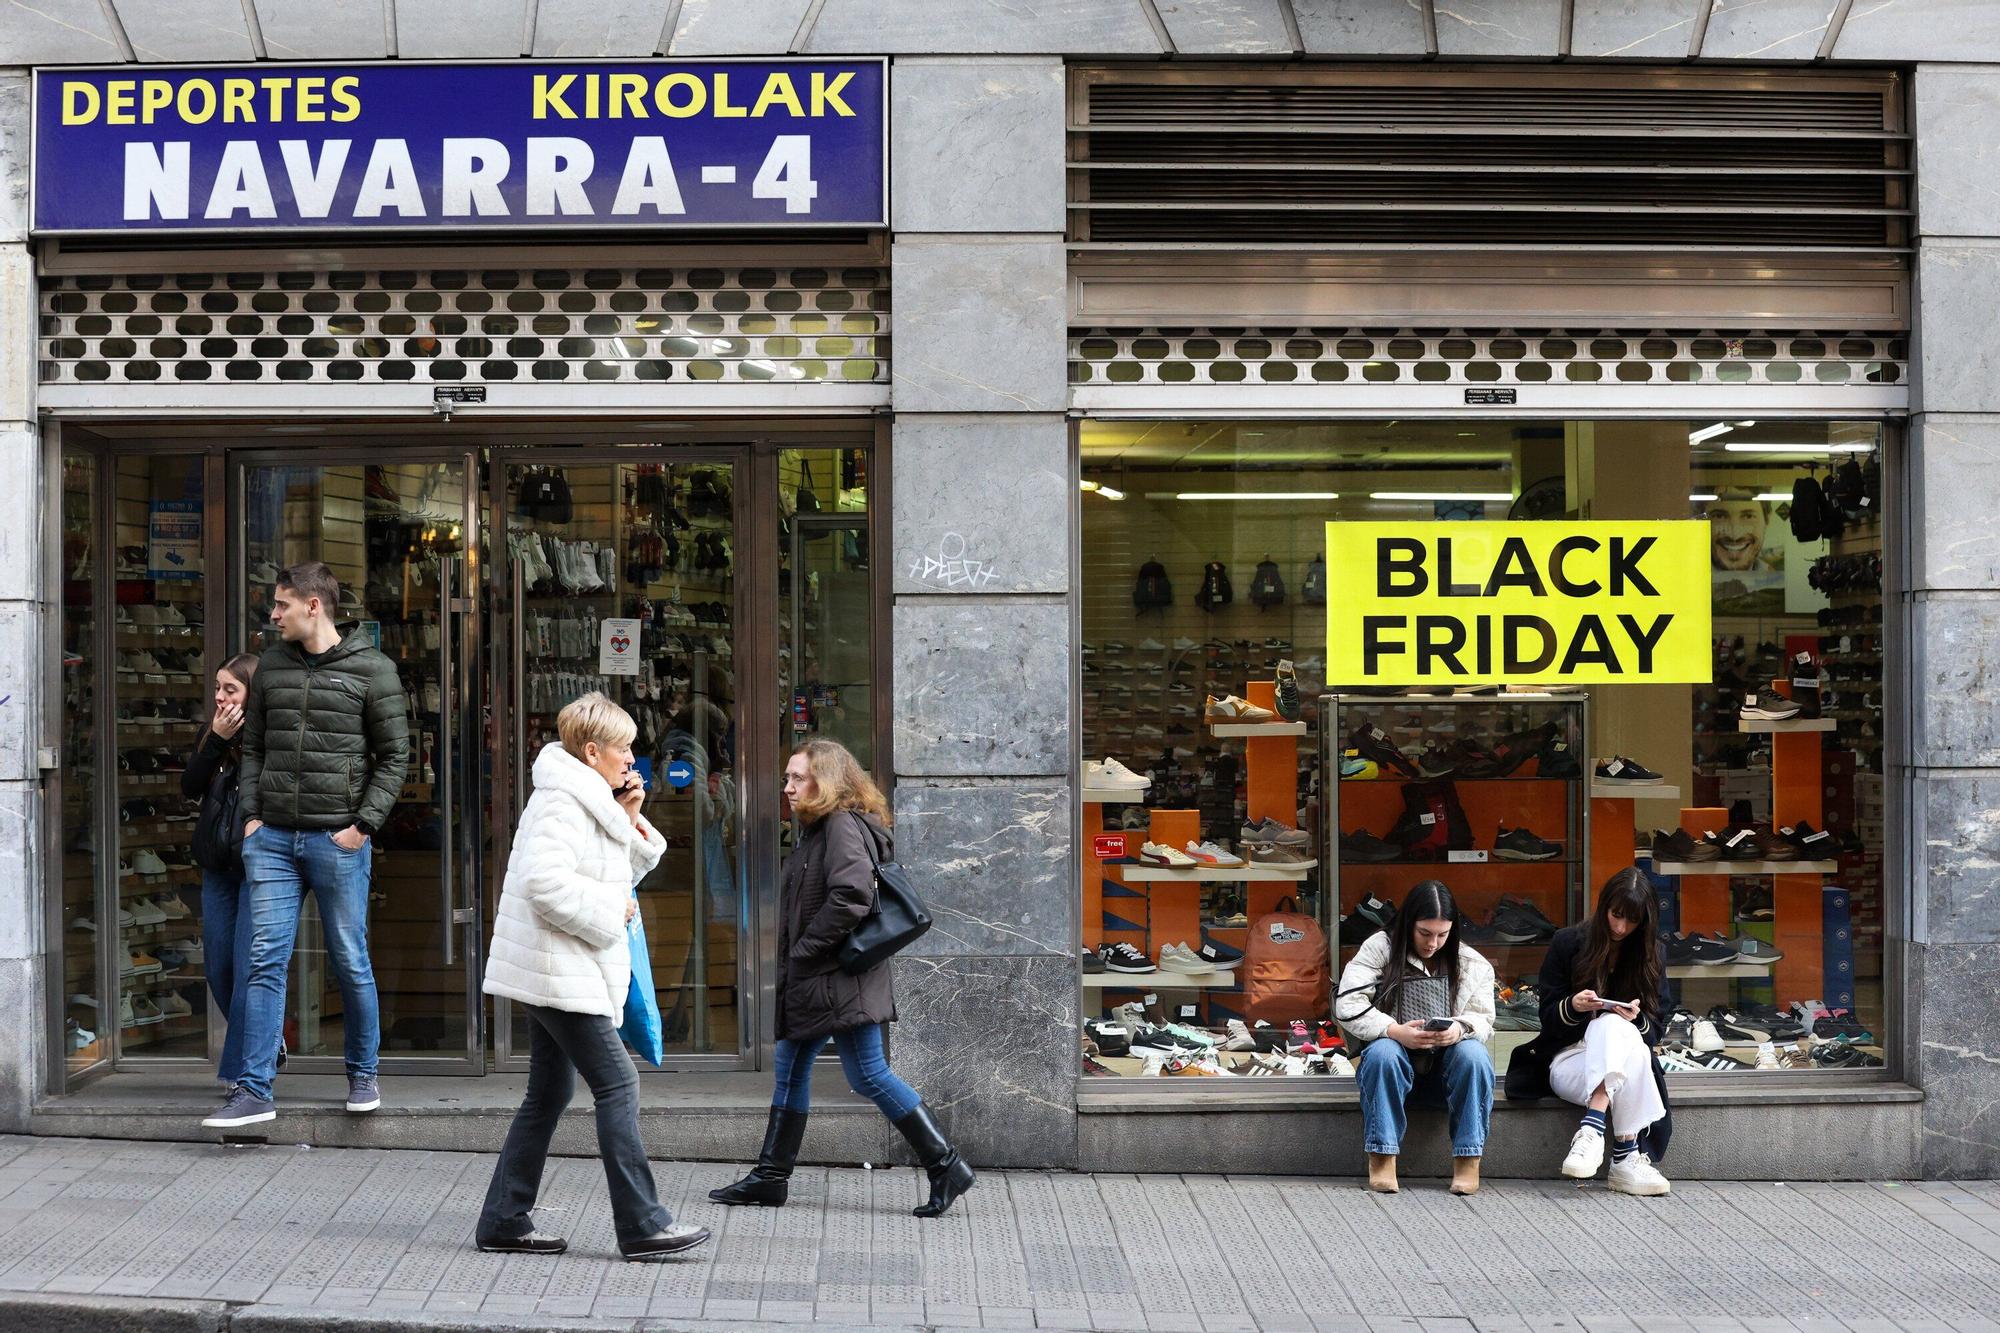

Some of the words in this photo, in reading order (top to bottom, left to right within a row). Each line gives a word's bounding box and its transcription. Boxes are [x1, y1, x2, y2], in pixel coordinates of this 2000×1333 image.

[62, 76, 362, 126] DEPORTES
[532, 72, 857, 119] KIROLAK
[1376, 535, 1661, 598] BLACK
[1363, 614, 1675, 676] FRIDAY
